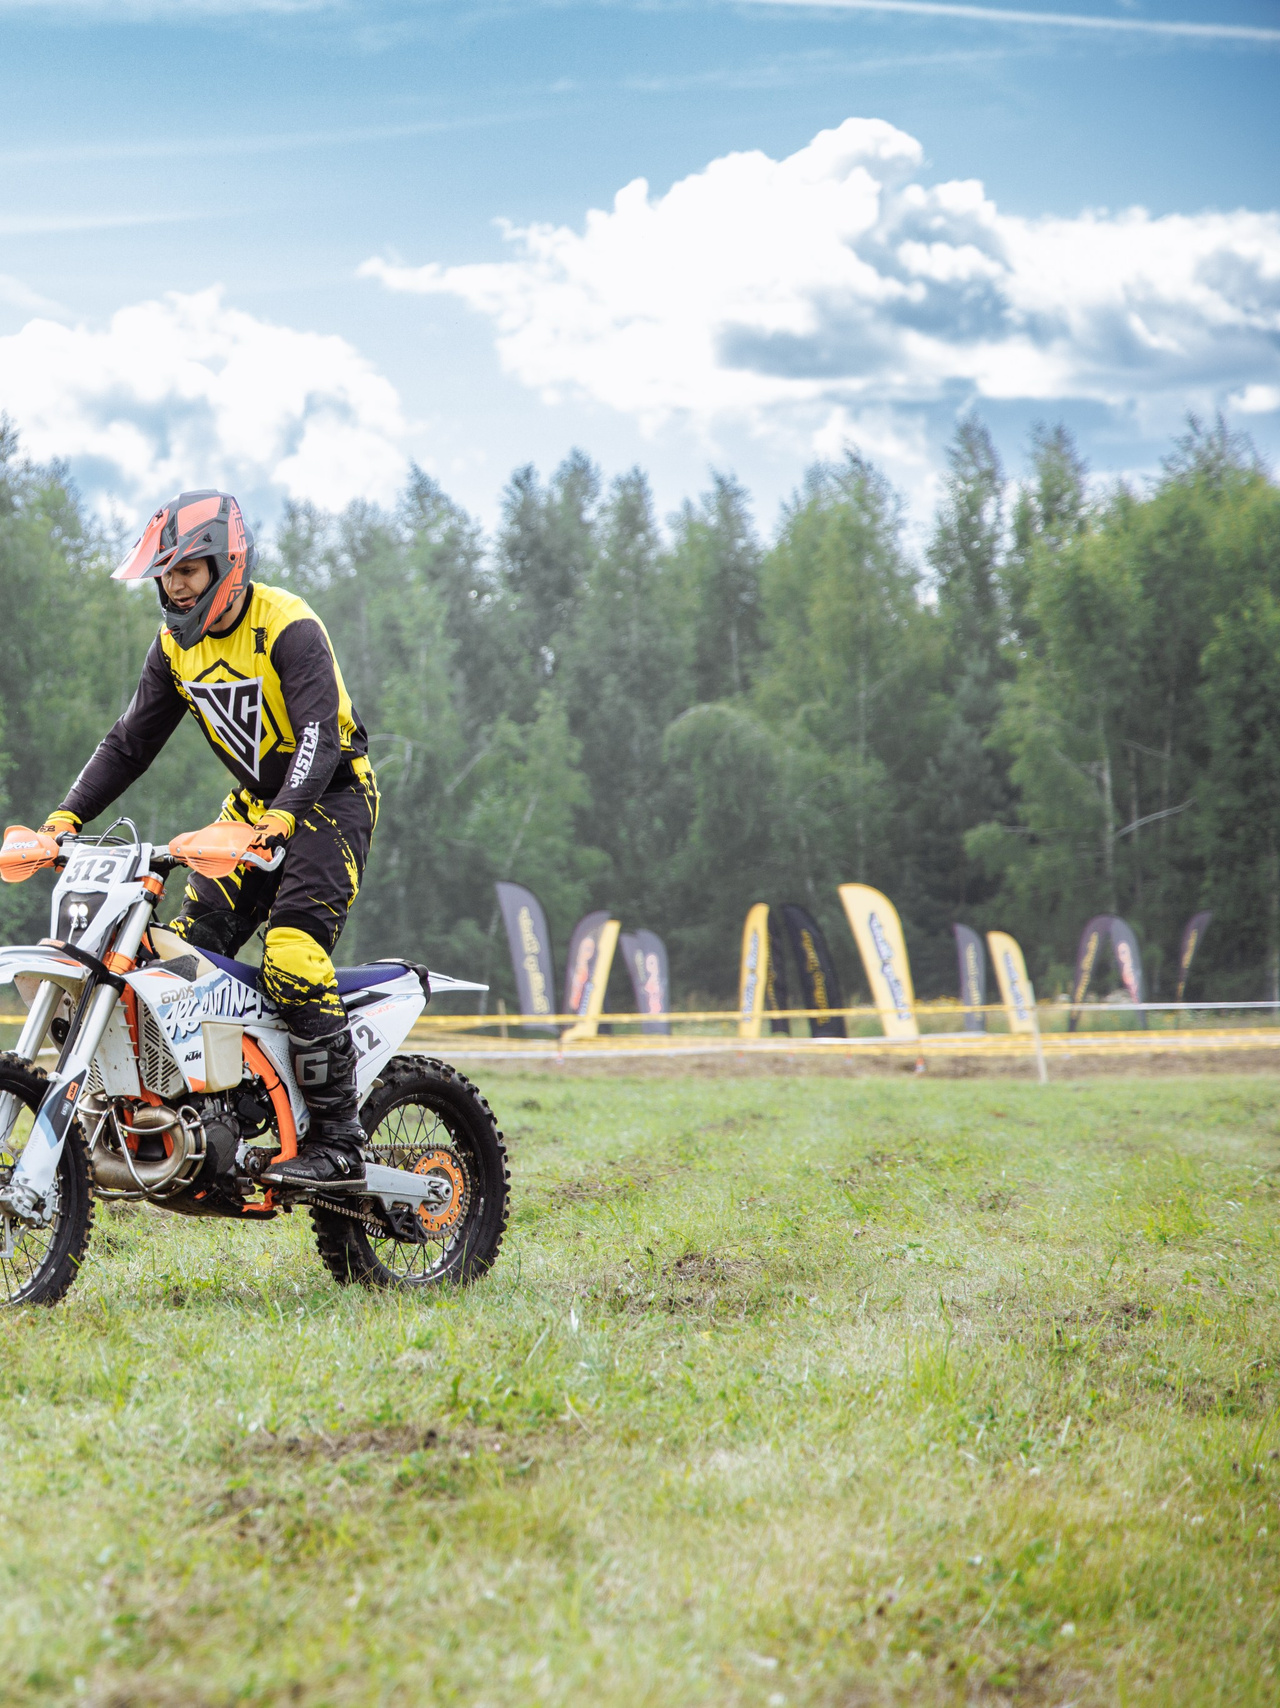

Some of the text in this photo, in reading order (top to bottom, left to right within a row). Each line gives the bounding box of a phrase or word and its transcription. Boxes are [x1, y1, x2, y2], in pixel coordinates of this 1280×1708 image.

[65, 859, 117, 884] 312
[160, 985, 195, 1004] 6DAYS
[184, 1050, 202, 1062] KTM
[296, 1050, 328, 1086] G
[69, 1084, 77, 1098] KTM
